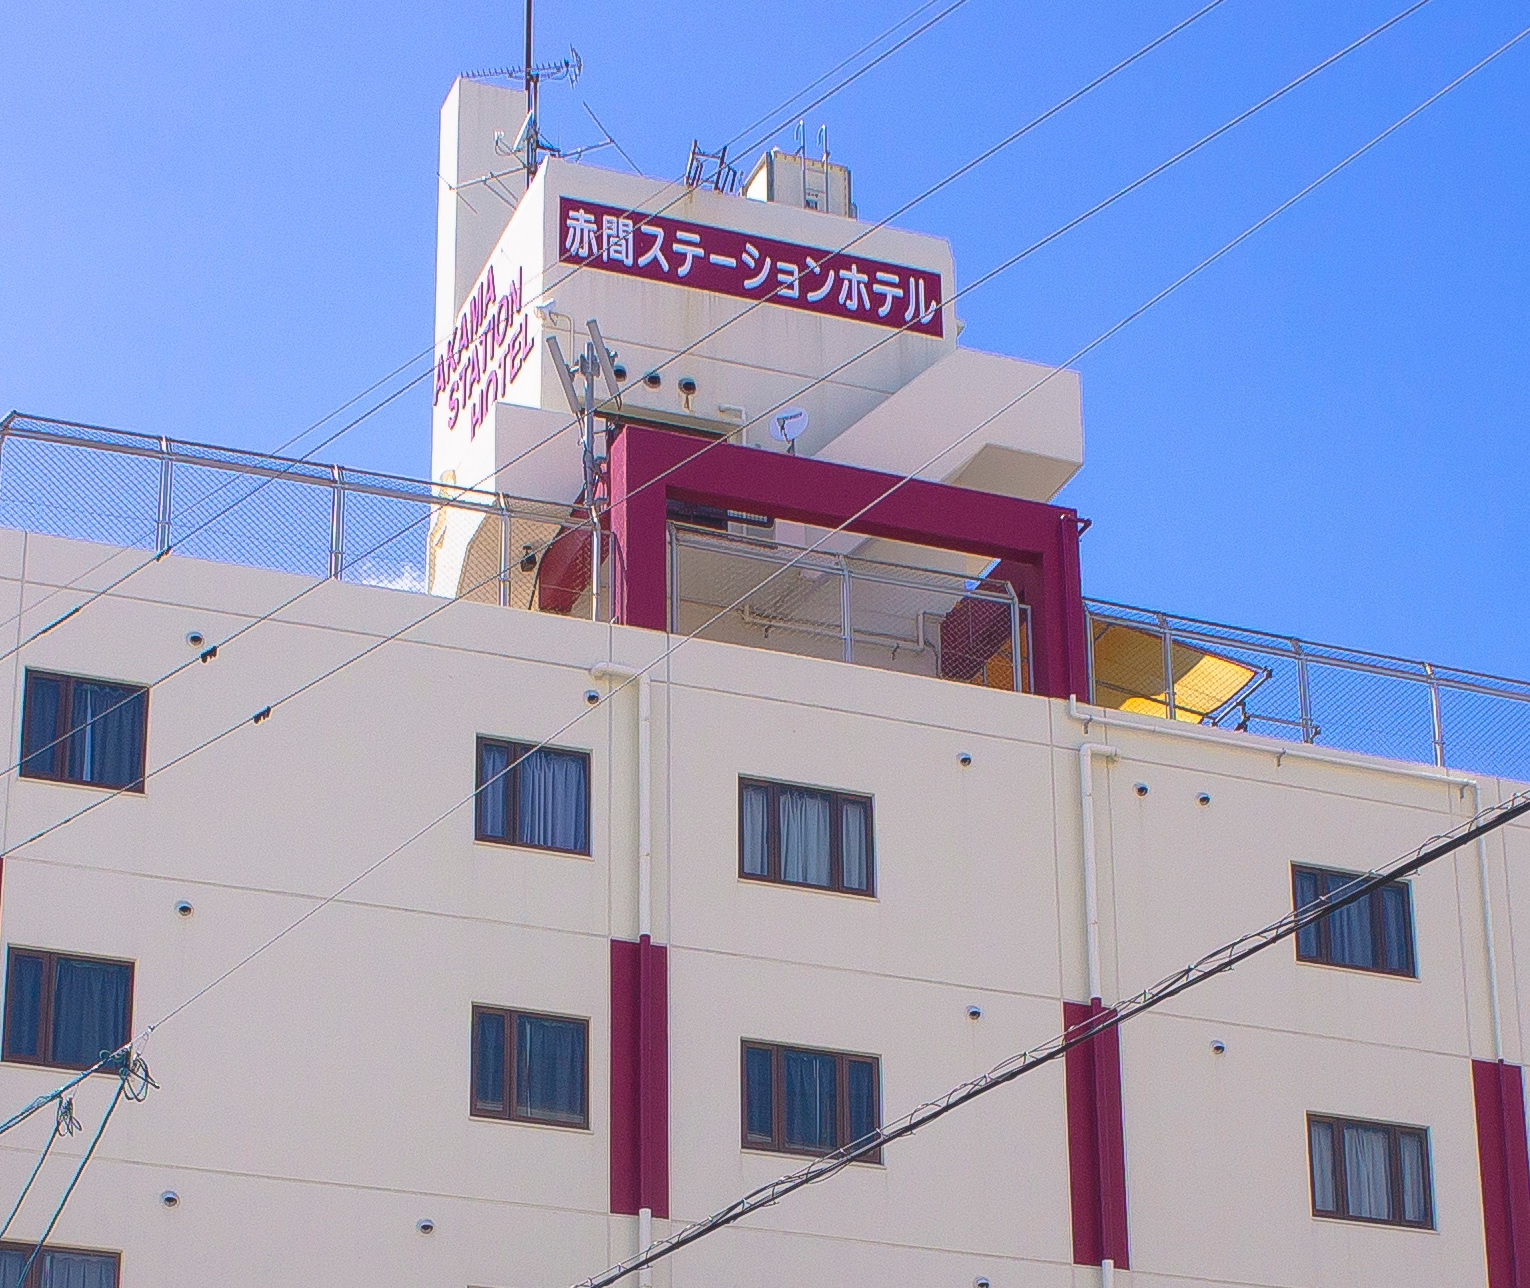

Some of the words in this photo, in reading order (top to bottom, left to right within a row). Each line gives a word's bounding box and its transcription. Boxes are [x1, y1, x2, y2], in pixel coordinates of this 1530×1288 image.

[565, 208, 937, 325] 赤間ステーションホテル
[433, 264, 496, 407] AKAMA
[448, 265, 523, 431] STATION
[470, 313, 535, 442] HOTEL
